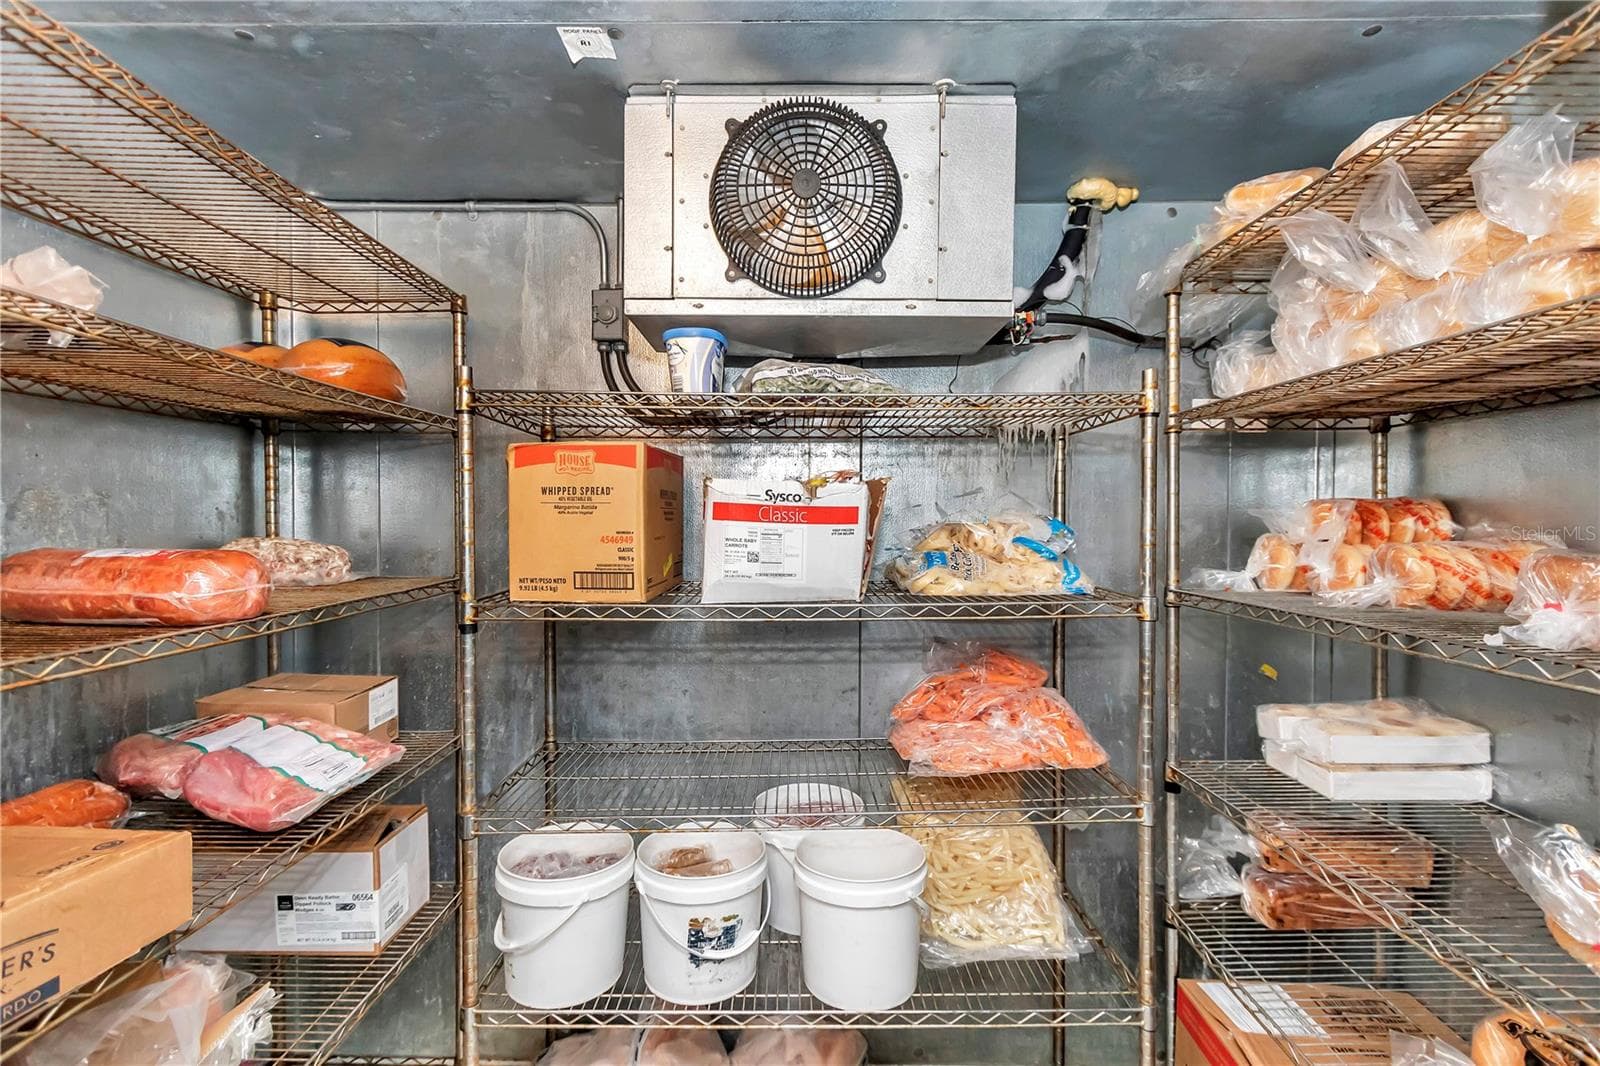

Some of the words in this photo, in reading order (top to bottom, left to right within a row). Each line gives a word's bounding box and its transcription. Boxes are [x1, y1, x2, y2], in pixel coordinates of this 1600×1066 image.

[559, 454, 592, 466] HOUSE
[541, 486, 577, 496] WHIPPED
[765, 489, 802, 504] Sysco
[758, 506, 808, 523] Classic
[600, 535, 634, 544] 4546949
